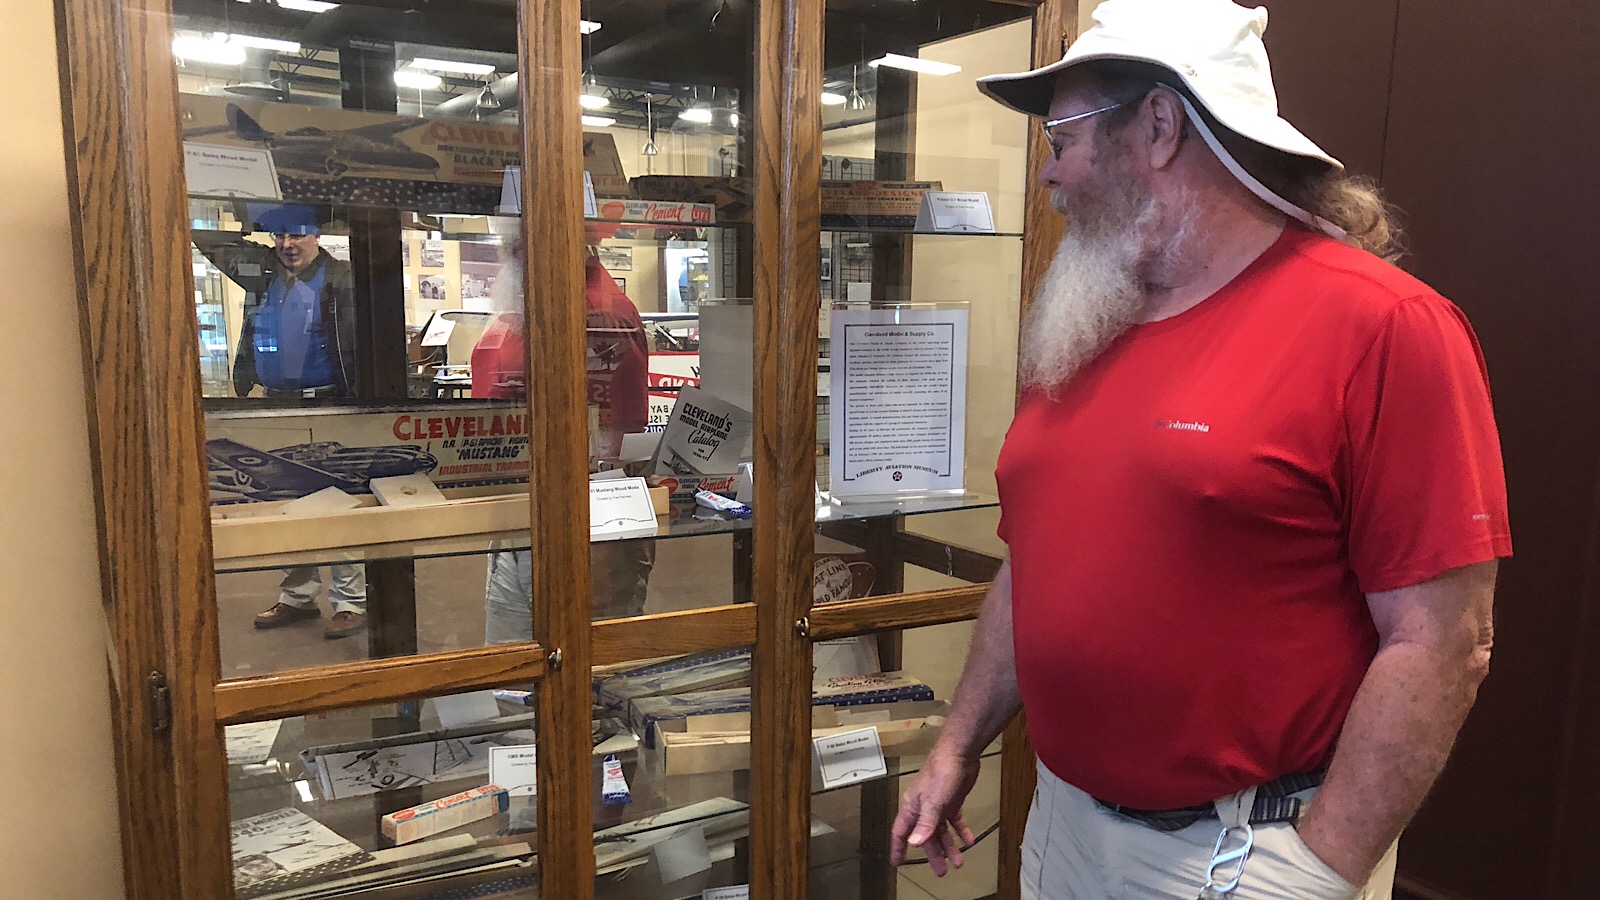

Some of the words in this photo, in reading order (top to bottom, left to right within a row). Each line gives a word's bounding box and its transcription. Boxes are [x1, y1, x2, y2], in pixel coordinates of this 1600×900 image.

[454, 153, 495, 167] BLACK
[644, 203, 685, 221] Cement
[683, 403, 733, 433] CLEVELAND'S
[680, 415, 699, 428] MODEL
[700, 423, 729, 441] AIRPLANE
[1164, 419, 1210, 433] olumbia
[439, 461, 493, 475] INDUSTRIAL
[856, 466, 884, 478] LIBERTY
[914, 465, 939, 475] MUSEUM
[697, 476, 735, 491] Cement
[827, 563, 847, 576] LINE
[436, 791, 473, 810] Cement
